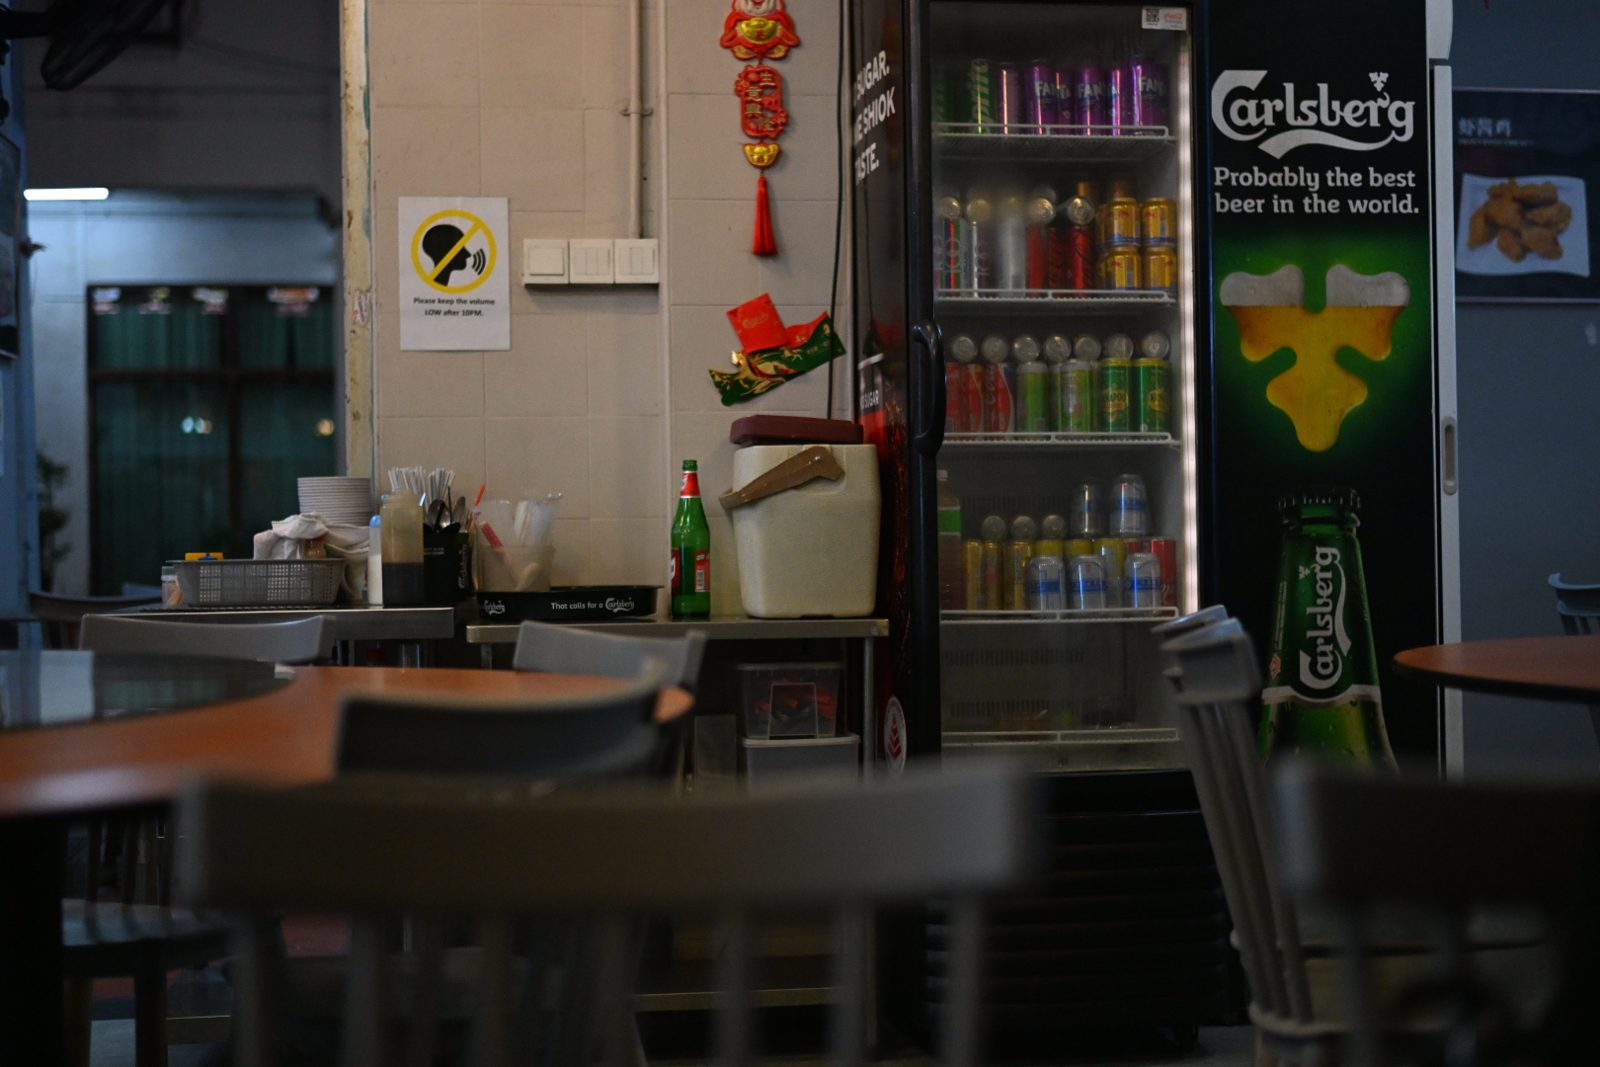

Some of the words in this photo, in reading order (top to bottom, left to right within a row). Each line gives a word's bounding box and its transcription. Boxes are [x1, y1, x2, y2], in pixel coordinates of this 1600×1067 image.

[863, 86, 896, 135] SHIOK
[1211, 69, 1416, 160] Carlsberg
[1214, 166, 1319, 192] Probably
[1325, 166, 1363, 187] the
[1368, 166, 1416, 187] best
[1214, 193, 1265, 214] beer
[1272, 193, 1294, 214] in
[1302, 194, 1340, 214] the
[1347, 193, 1420, 214] world.
[413, 297, 436, 305] Please
[437, 297, 454, 306] keep
[456, 297, 467, 305] the
[551, 602, 567, 610] That
[569, 602, 585, 610] calls
[587, 601, 597, 609] for
[1298, 545, 1352, 690] Carlsberg
